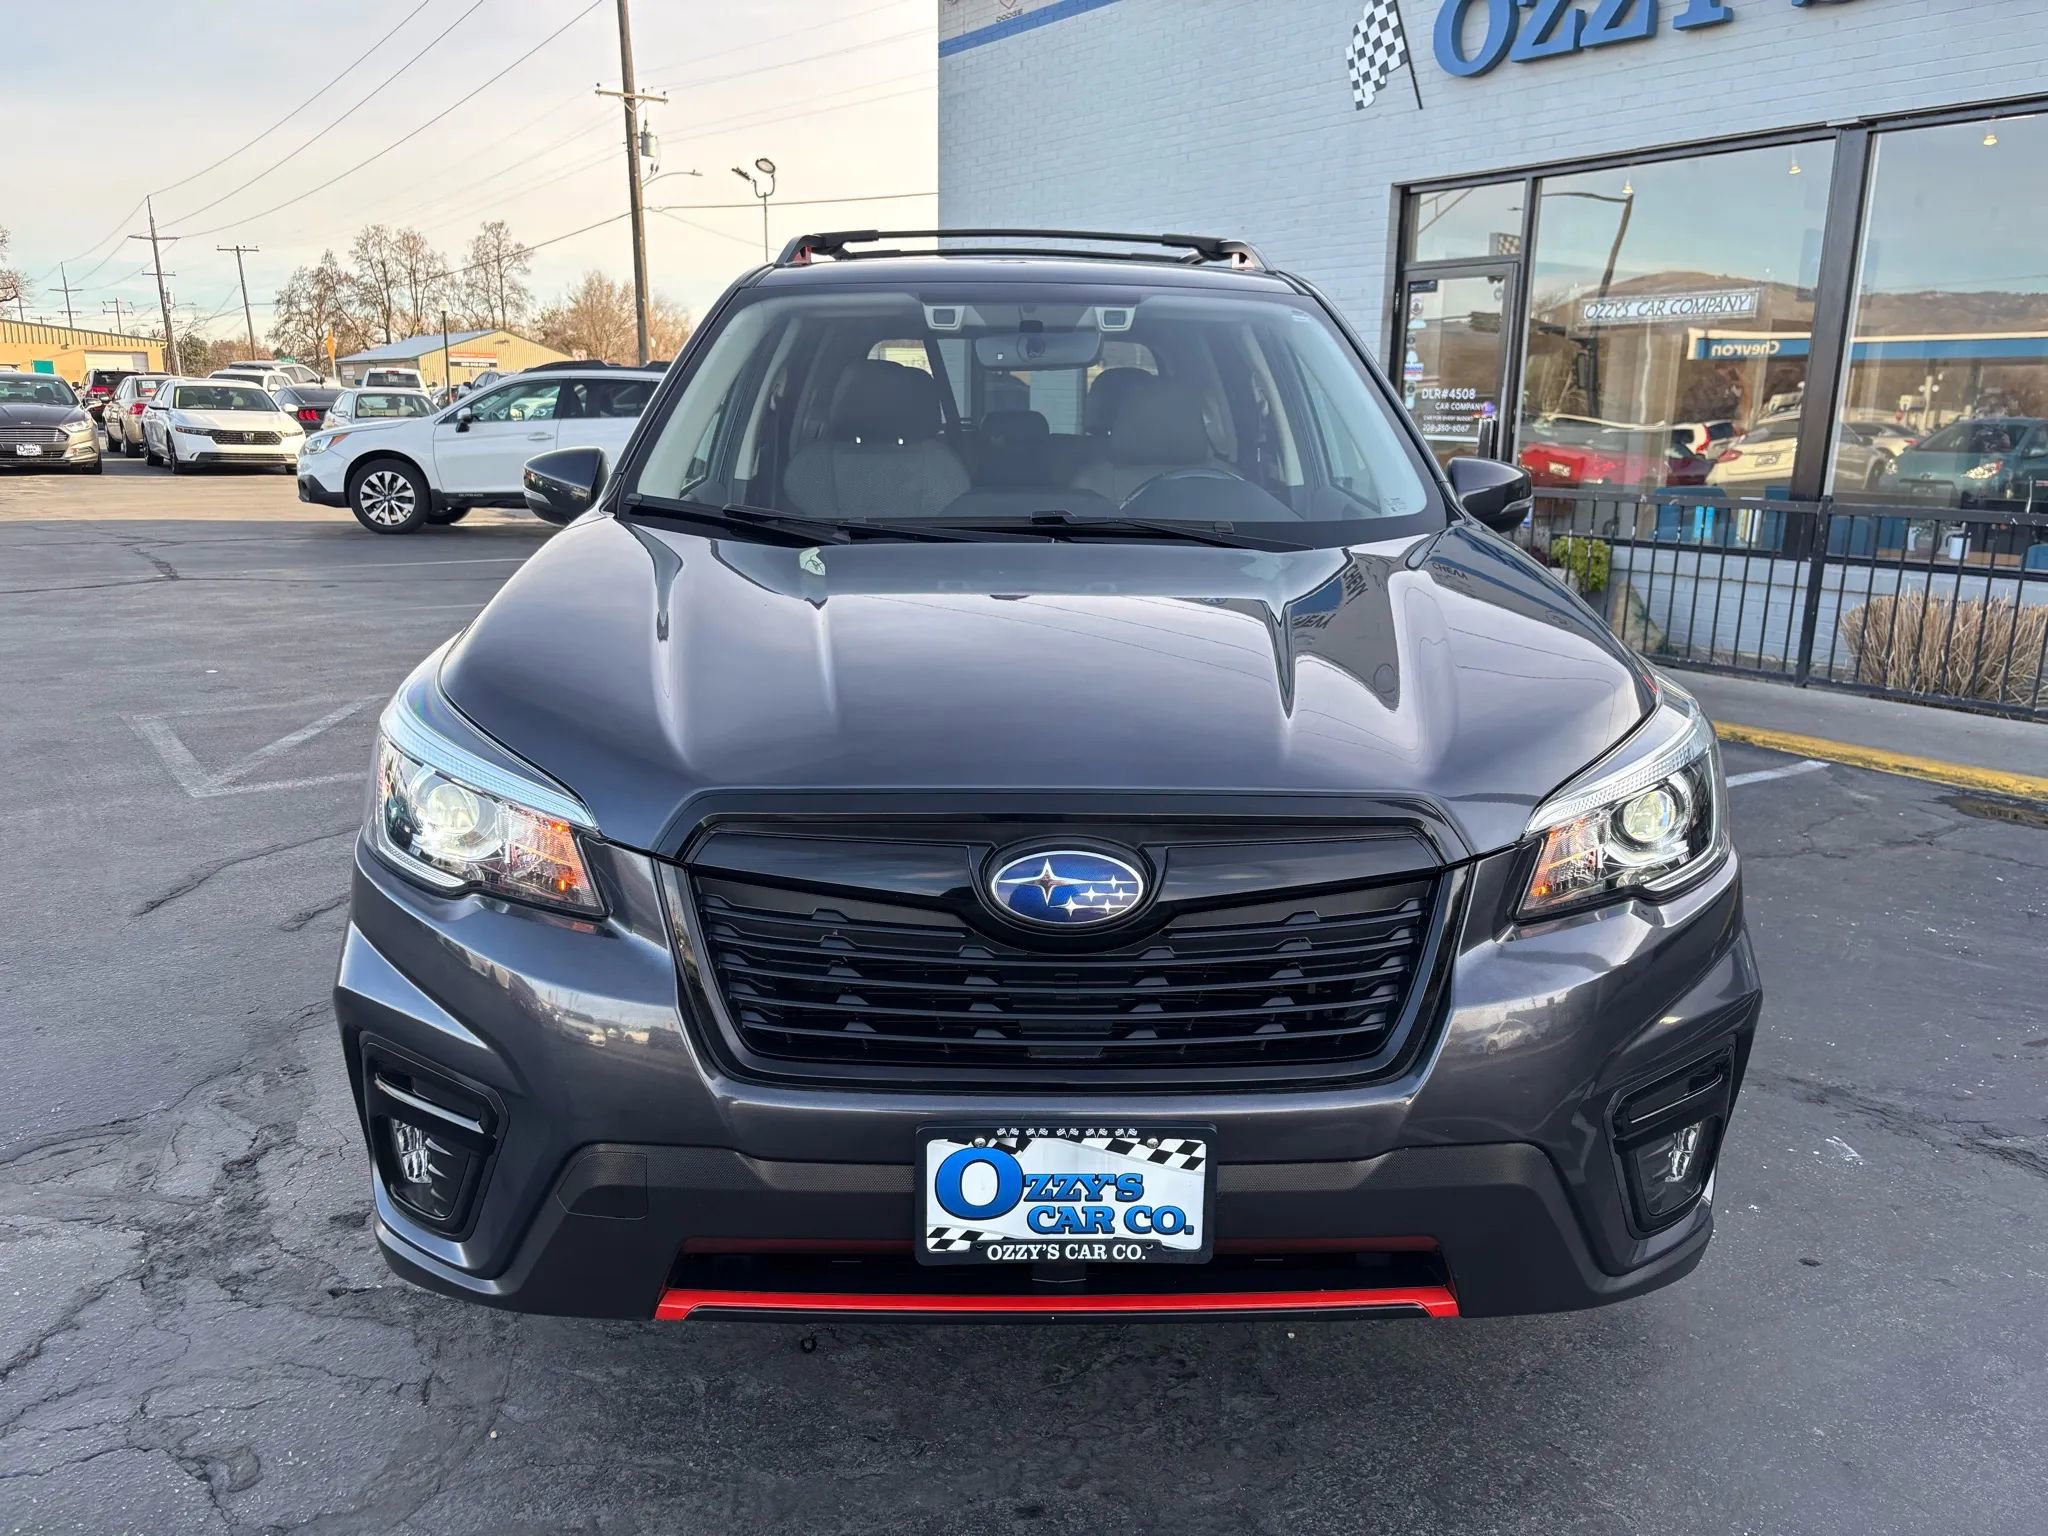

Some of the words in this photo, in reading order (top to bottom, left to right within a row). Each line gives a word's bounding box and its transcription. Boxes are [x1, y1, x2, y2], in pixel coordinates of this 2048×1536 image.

[1636, 298, 1665, 317] CAR
[1670, 294, 1748, 314] COMPANY
[1421, 387, 1477, 399] DLR#4508
[1434, 401, 1450, 411] CAR
[1451, 401, 1485, 411] COMPANY
[935, 1146, 1144, 1220] OZZY'S
[1027, 1205, 1115, 1235] CAR
[1124, 1205, 1194, 1235] CO.
[987, 1243, 1060, 1261] OZZY'S
[1065, 1243, 1108, 1260] CAR
[1112, 1243, 1147, 1260] CO.
